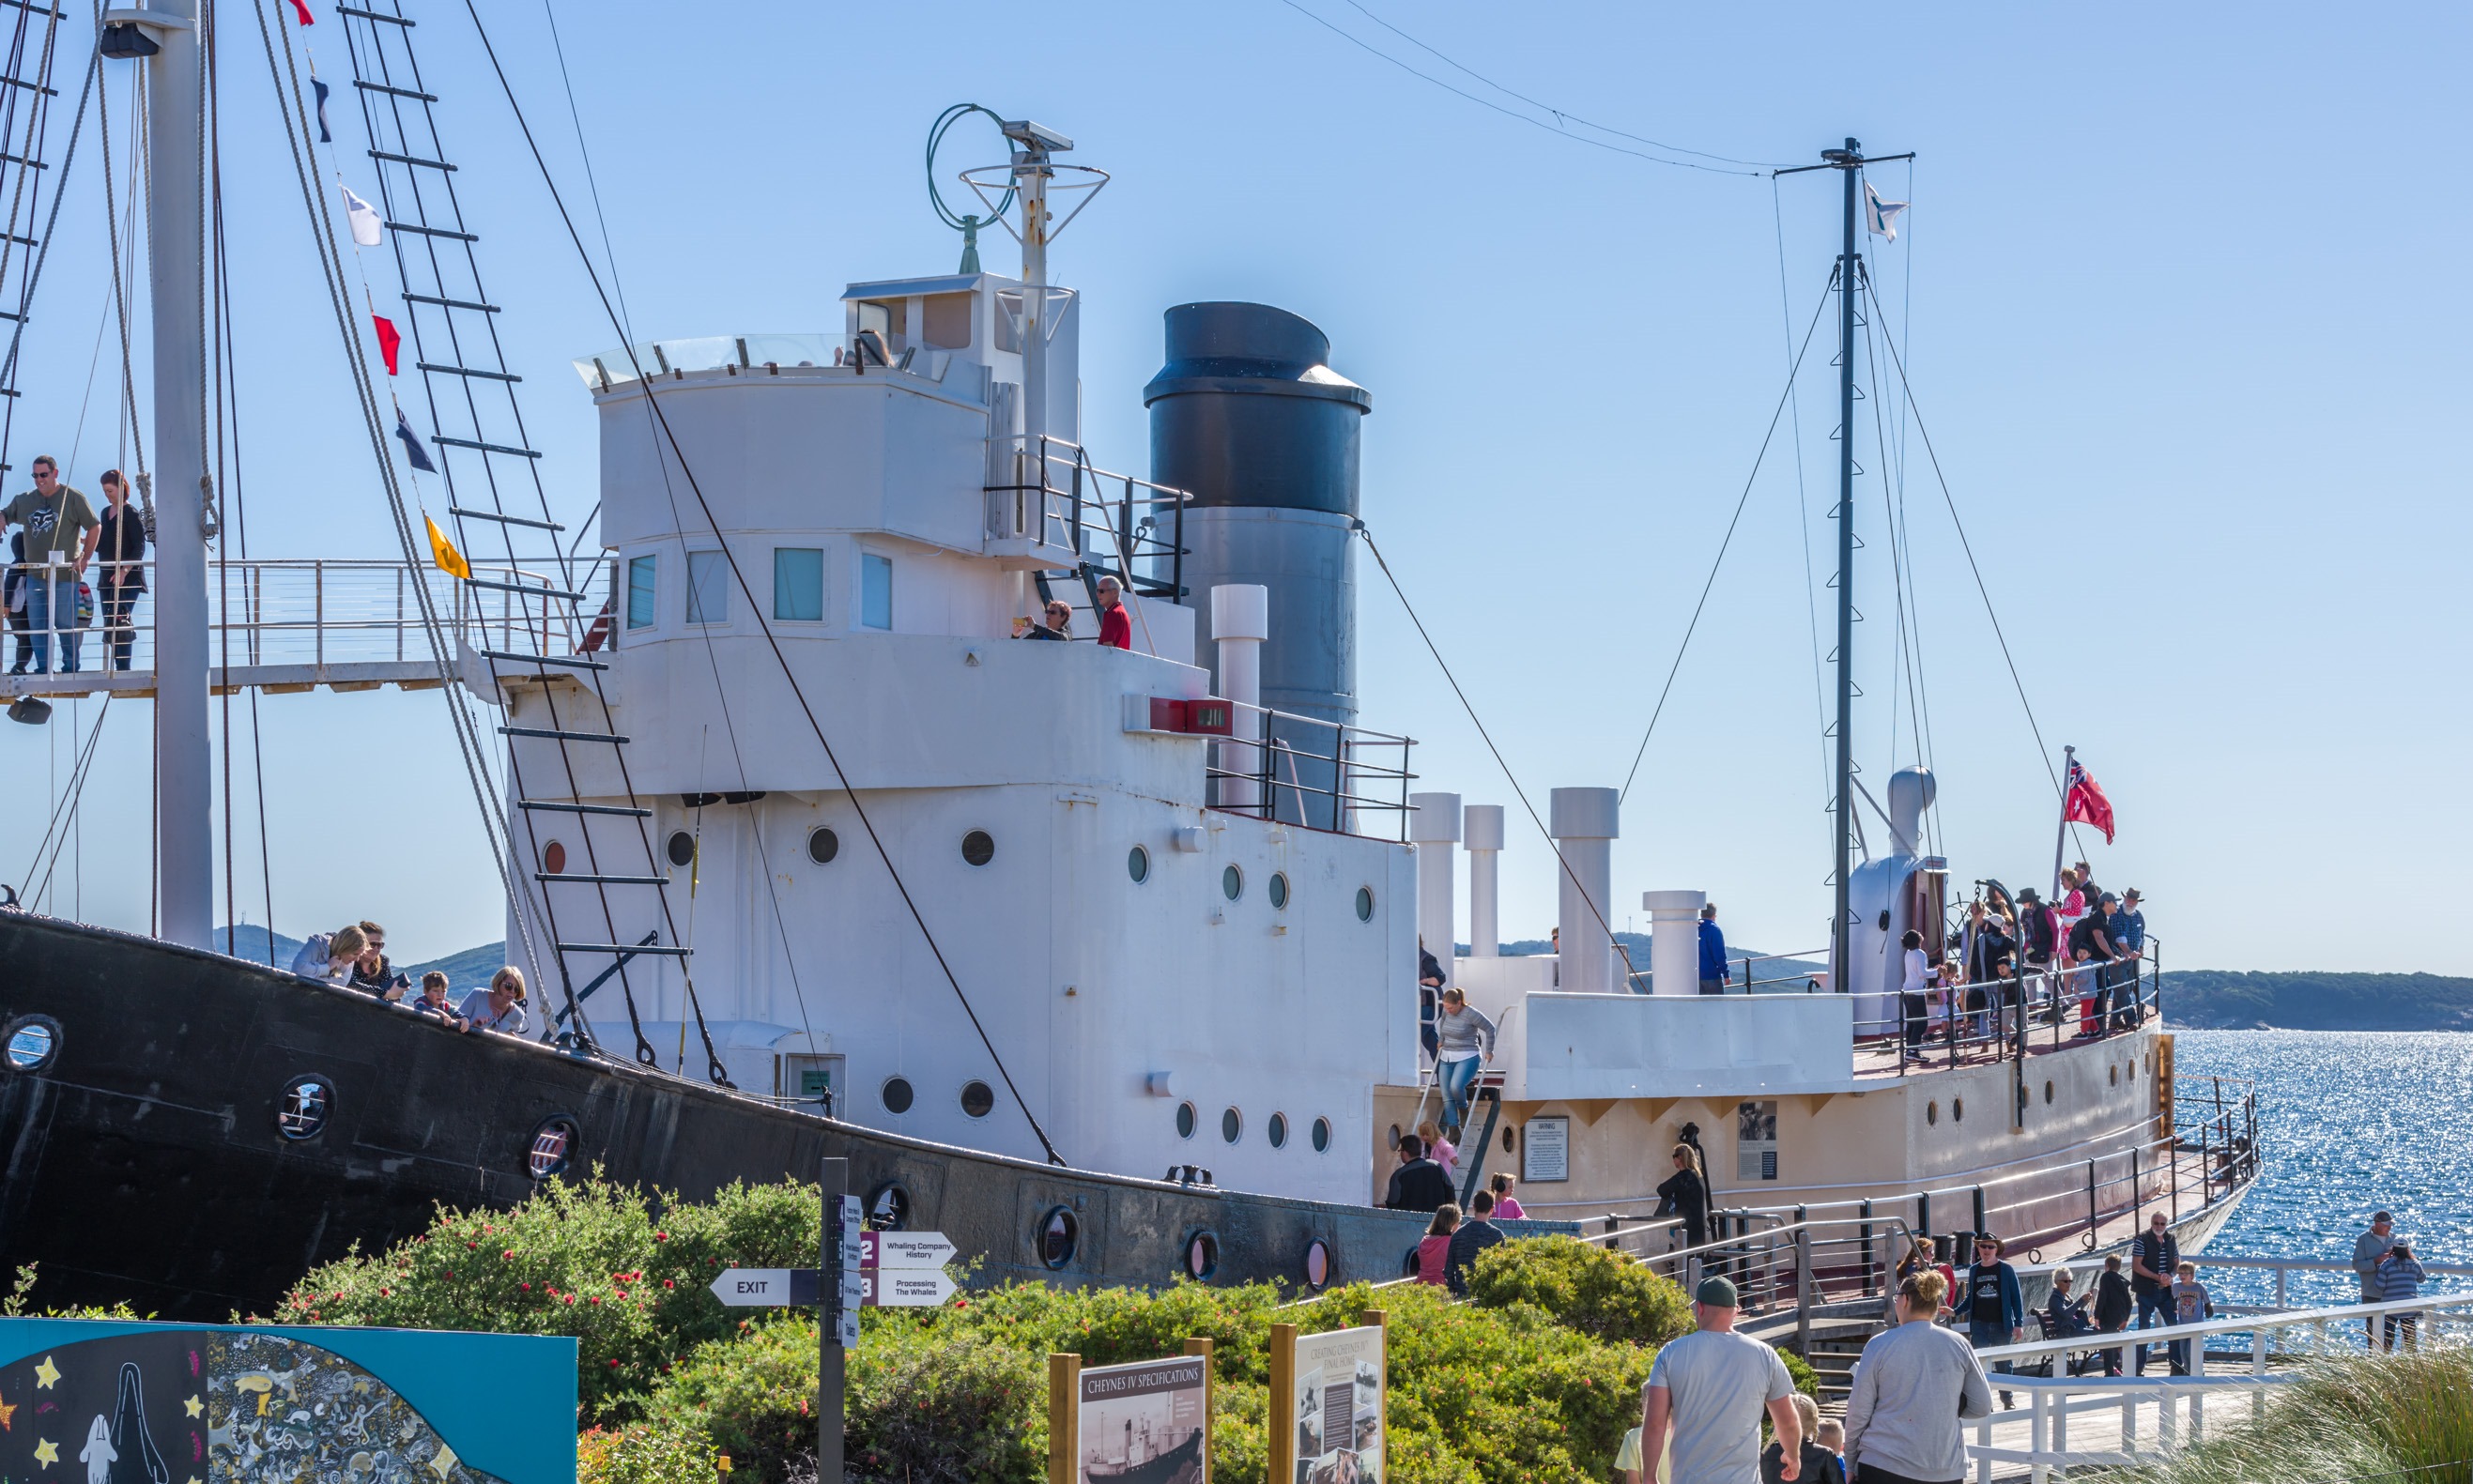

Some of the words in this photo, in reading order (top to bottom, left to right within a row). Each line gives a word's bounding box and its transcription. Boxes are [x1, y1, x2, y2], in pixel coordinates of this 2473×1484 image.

[838, 1240, 843, 1260] 5
[861, 1240, 873, 1260] 2
[887, 1242, 916, 1251] Whaling
[917, 1242, 951, 1251] Company
[737, 1281, 768, 1293] EXIT
[838, 1278, 842, 1298] 6
[862, 1277, 872, 1297] 3
[896, 1279, 936, 1289] Processing
[846, 1323, 855, 1338] Toilets
[1311, 1345, 1337, 1360] CREATING
[1337, 1341, 1359, 1356] CHEYNES
[1324, 1356, 1339, 1370] FINAL
[1339, 1354, 1356, 1368] HOME
[1087, 1376, 1127, 1394] CHEYNES
[1128, 1376, 1136, 1389] IV
[1138, 1367, 1199, 1388] SPECIFICATIONS
